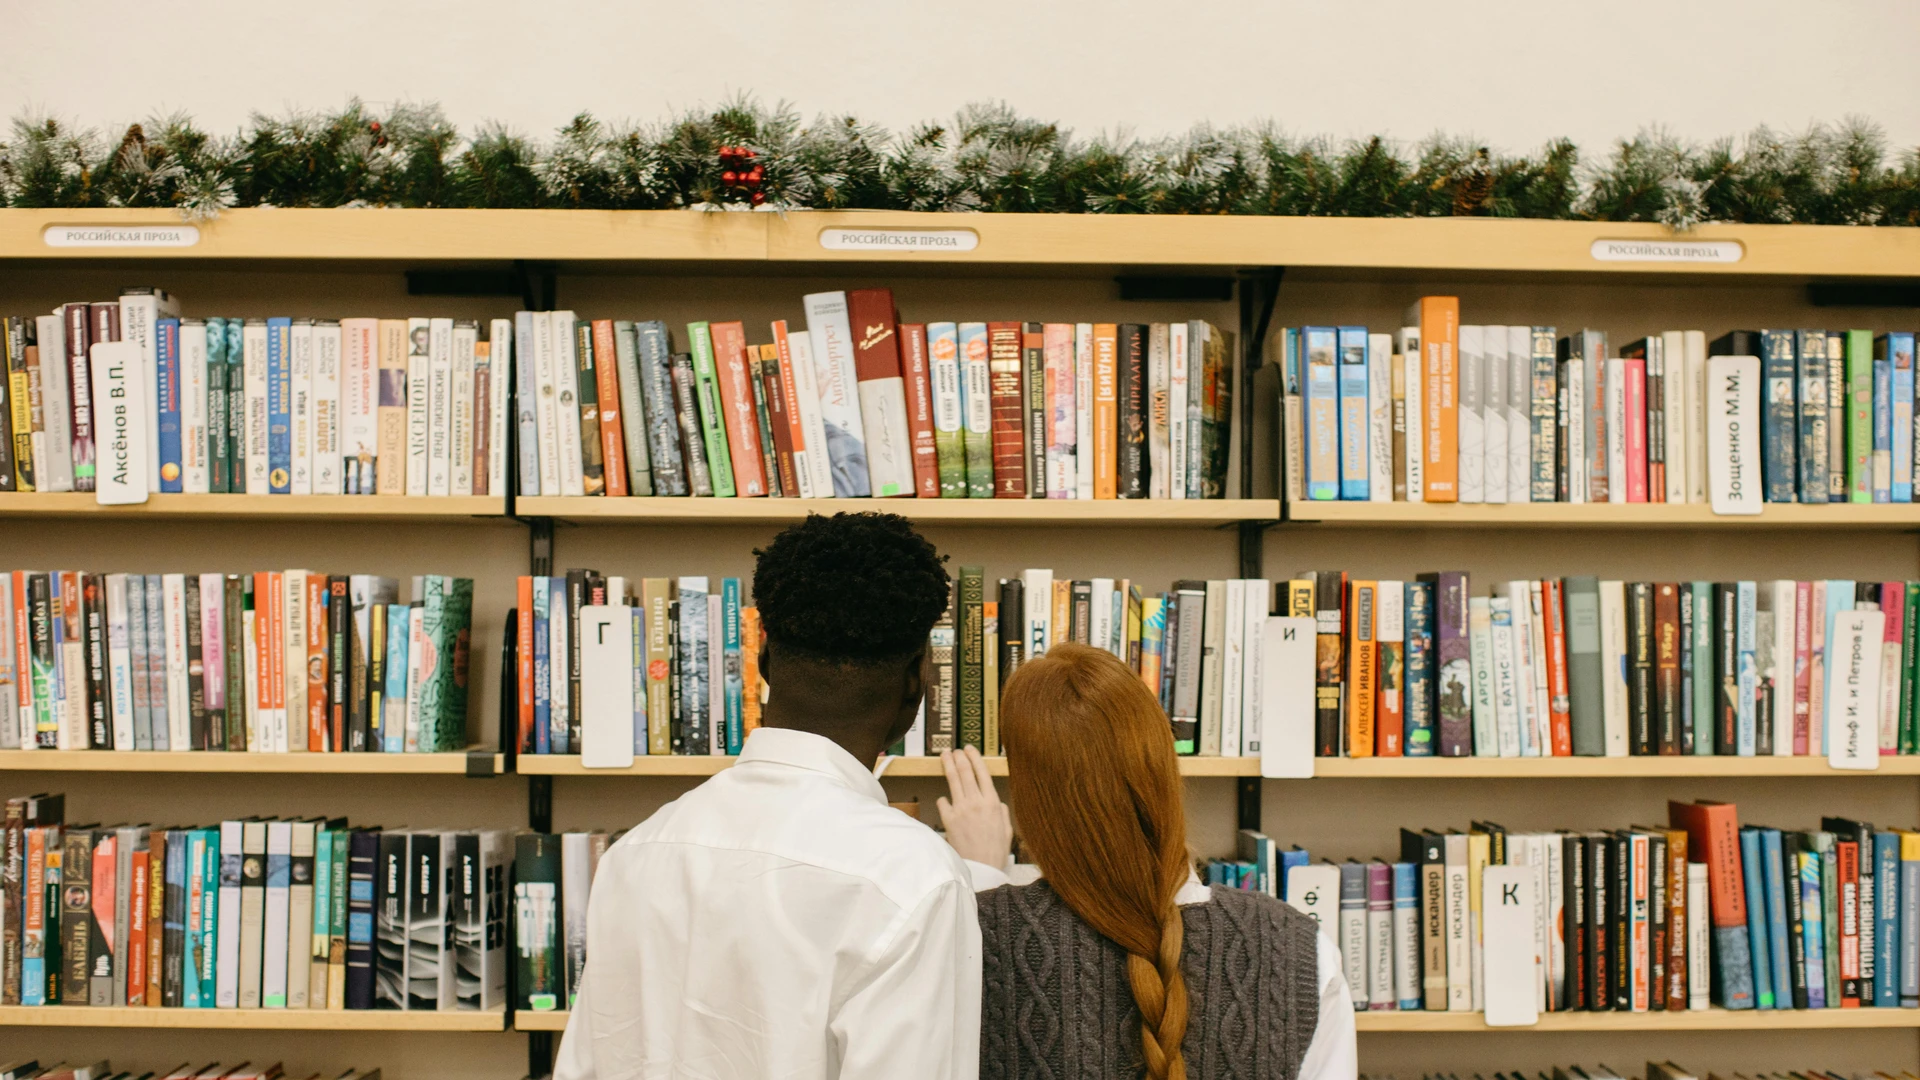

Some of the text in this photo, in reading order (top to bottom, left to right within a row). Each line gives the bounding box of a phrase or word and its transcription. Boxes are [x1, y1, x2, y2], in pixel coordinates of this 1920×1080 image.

[66, 230, 180, 242] РОССИЙСКАЯ ПРОЗА
[842, 233, 957, 247] РОССИЙСКАЯ ПРОЗА
[1608, 244, 1719, 258] РОССИЙСКАЯ ПРОЗА
[695, 328, 709, 374] Владимир
[824, 324, 844, 406] Автопортрет
[1130, 332, 1141, 410] ПРЕДАТЕЛЬ
[1442, 343, 1452, 375] ПОВЕСТЬ
[109, 361, 128, 485] Аксёнов В.П.
[209, 390, 217, 428] ПОИСКАХ
[230, 392, 238, 430] ПОИСКАХ
[296, 391, 307, 458] ЖЕЛТОК ЯЙЦА
[317, 400, 328, 453] ЗОЛОТАЯ
[412, 378, 426, 460] АКСЕНОВ
[434, 368, 446, 459] ЛЕНД-ЛИЗОВСКИЕ
[1154, 391, 1166, 425] АЛИСА
[1394, 400, 1406, 432] Даша
[1430, 374, 1441, 429] ТЕРЕНТЬЕВИЧА
[217, 414, 225, 458] ГРУСТНОГО
[1034, 412, 1044, 455] ВОЙНОВИЧ
[1430, 430, 1441, 462] ЗАЙЦЕВА
[1541, 417, 1554, 479] ЗАМЯТИН
[1726, 370, 1744, 501] Зощенко М.М.
[782, 452, 793, 490] ВЛАДИМОВ
[598, 622, 610, 644] Г
[651, 597, 664, 652] Галина
[727, 602, 735, 644] ГАНИЕВА
[1284, 628, 1295, 640] И
[1662, 622, 1675, 659] Убыр
[116, 665, 125, 714] КОЗУЛЬКА
[1358, 591, 1372, 736] АЛЕКСЕЙ ИВАНОВ НЕНАСТЬЕ
[1475, 633, 1489, 706] АРГОНАВТ
[1499, 630, 1512, 707] БАТИСКАФ
[1847, 620, 1864, 758] Ильф И. и Петров Е.
[940, 666, 953, 731] ГИЛЯРОВСКИЙ
[30, 849, 42, 925] Исаак БАБЕЛЬ
[318, 861, 328, 926] Андрей БЕЛЫЙ
[334, 862, 345, 927] Андрей БЕЛЫЙ
[1304, 886, 1320, 906] Ф.
[1429, 871, 1441, 937] искандер
[1453, 873, 1464, 939] искандер
[1502, 884, 1519, 905] К
[1843, 883, 1856, 936] КАСИМОВ
[72, 921, 87, 980] БАБЕЛЬ
[203, 891, 213, 980] ГОНКИ НА ЧЕРЕПАХАХ
[1348, 918, 1364, 990] искандер
[1407, 917, 1419, 988] искандер
[1860, 875, 1875, 978] СТОЛКНОВЕНИЕ
[1373, 920, 1389, 992] искандер
[49, 973, 57, 999] БАБЕЛЬ
